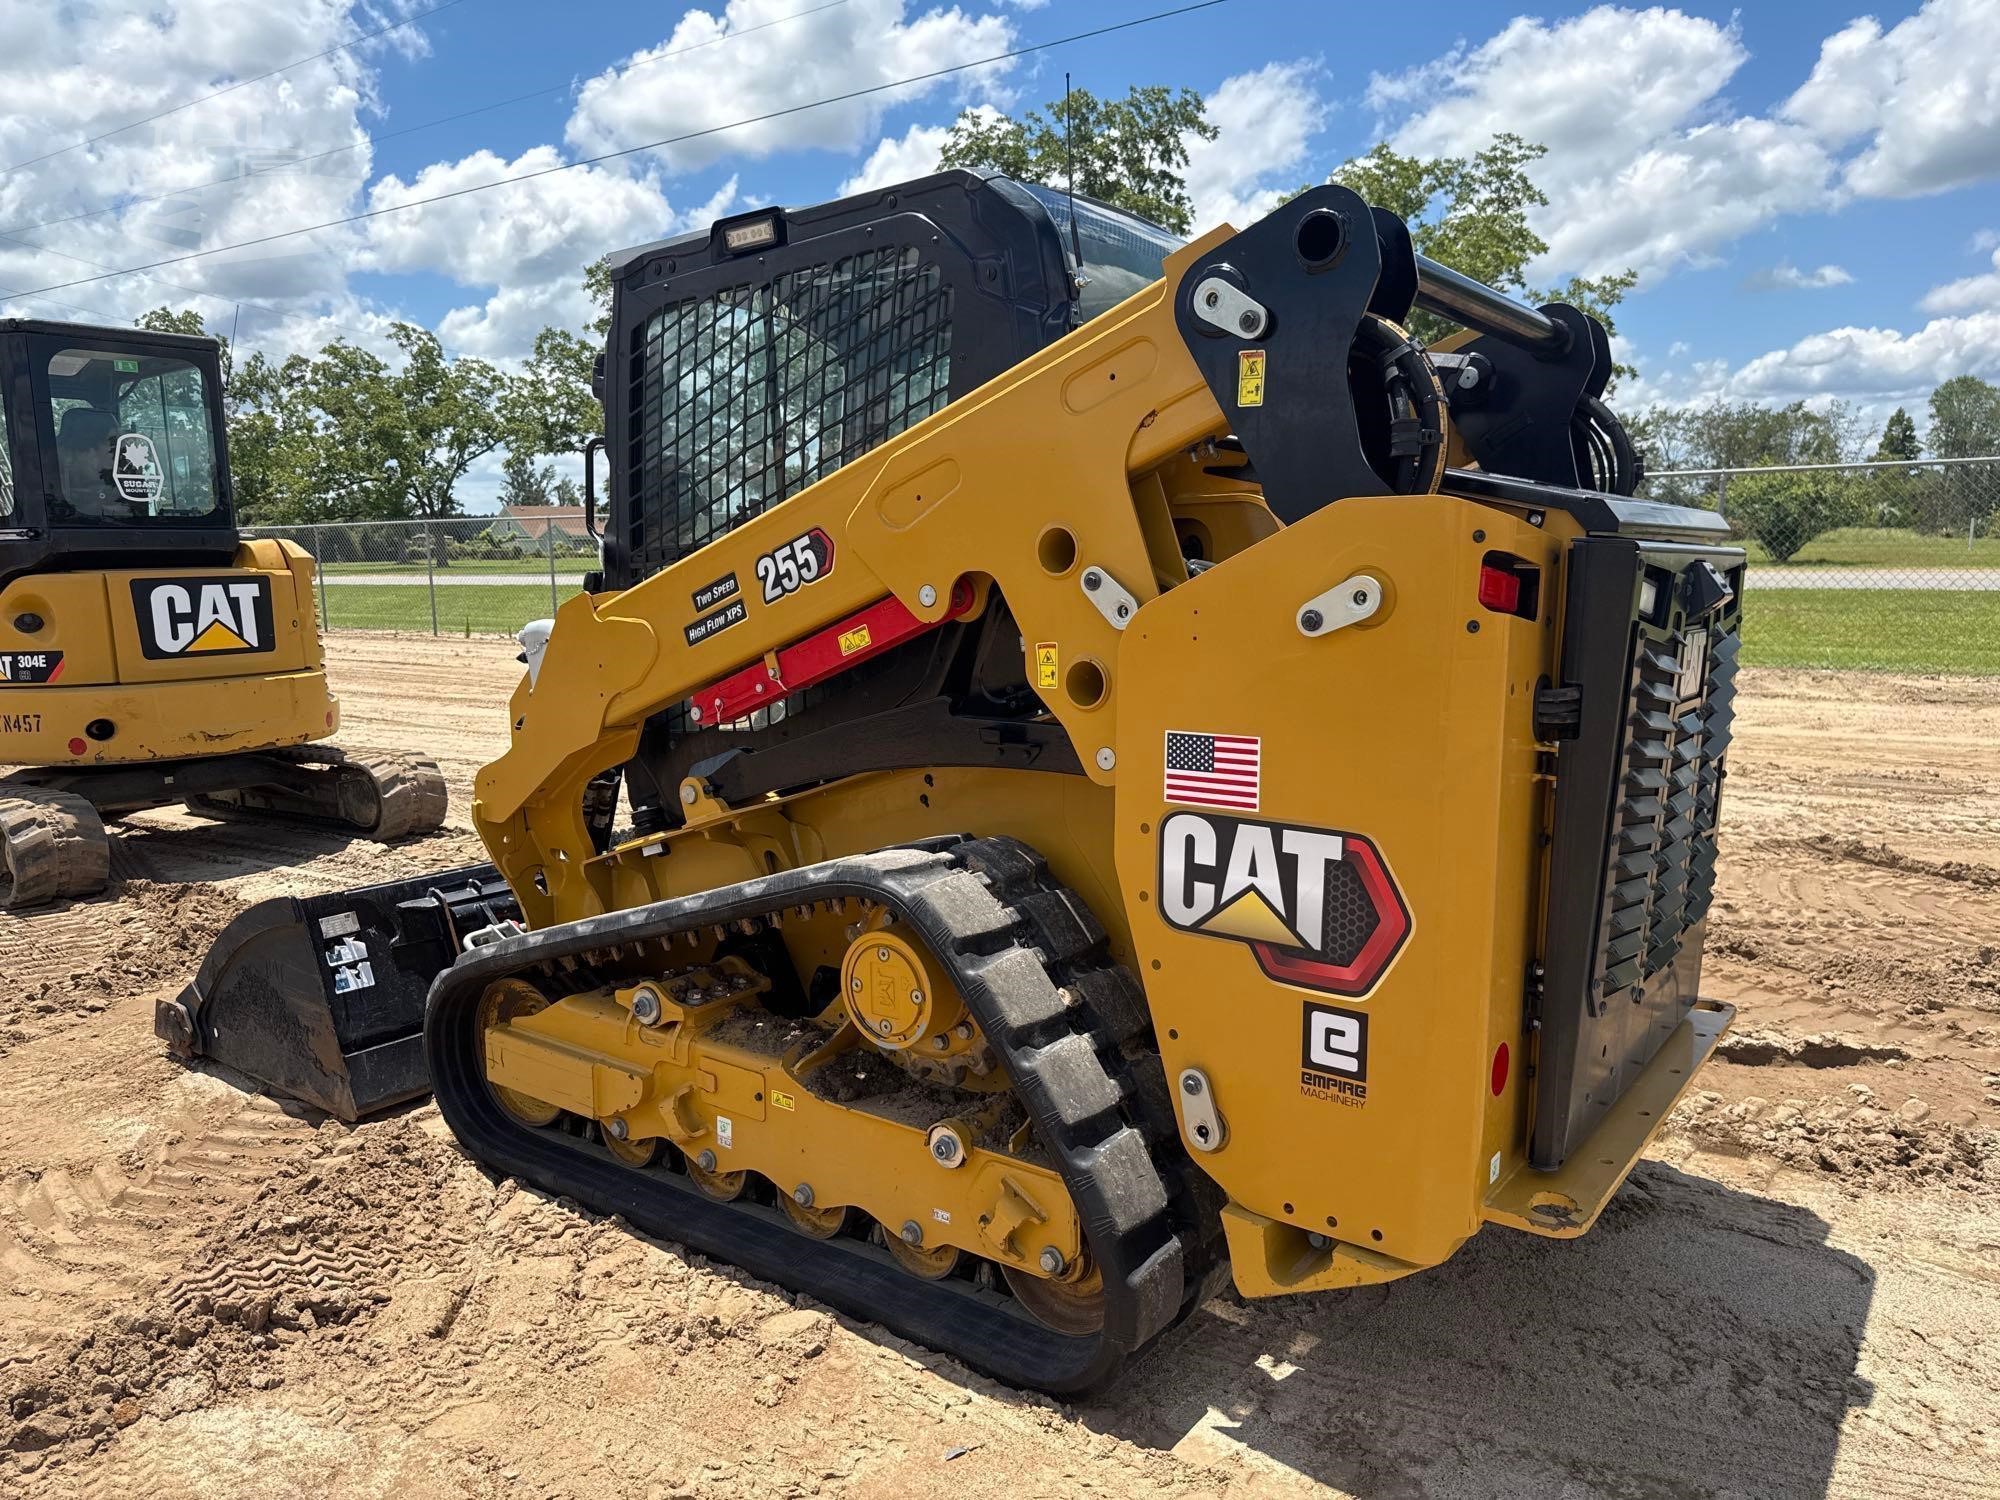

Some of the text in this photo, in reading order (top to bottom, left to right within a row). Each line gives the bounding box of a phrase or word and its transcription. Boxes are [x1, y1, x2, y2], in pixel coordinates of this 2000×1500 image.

[757, 535, 818, 601] 255
[150, 583, 260, 653] CAT
[726, 604, 743, 622] XPS
[18, 655, 47, 668] 304E
[1163, 814, 1342, 951] CAT
[1300, 1086, 1366, 1110] MACHINERY
